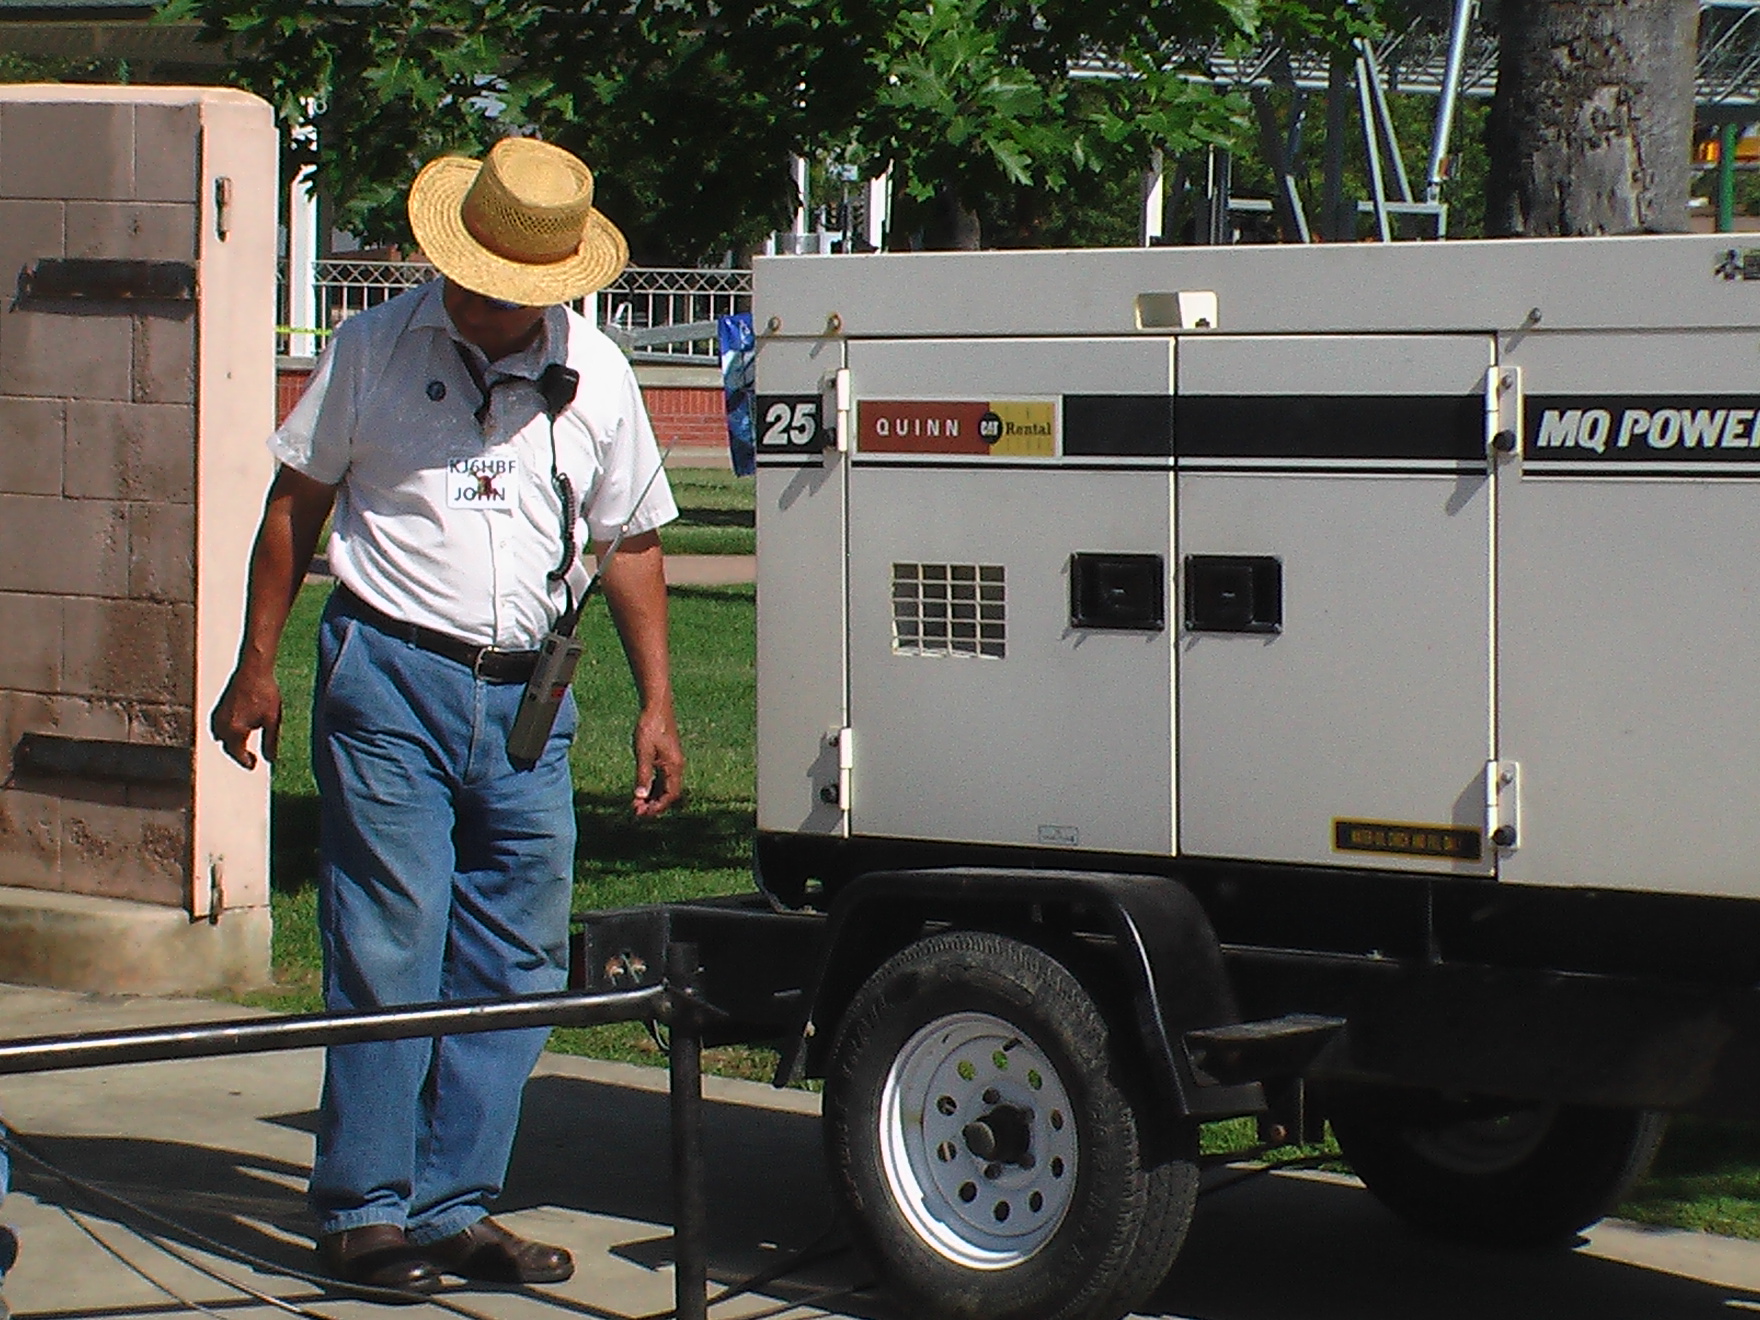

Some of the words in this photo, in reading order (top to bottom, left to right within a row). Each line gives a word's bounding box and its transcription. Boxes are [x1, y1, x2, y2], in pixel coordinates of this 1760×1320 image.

[763, 403, 816, 445] 25
[876, 418, 960, 437] QUINN
[980, 421, 999, 436] CAT
[1006, 422, 1051, 435] Rental
[1536, 410, 1611, 453] MQ
